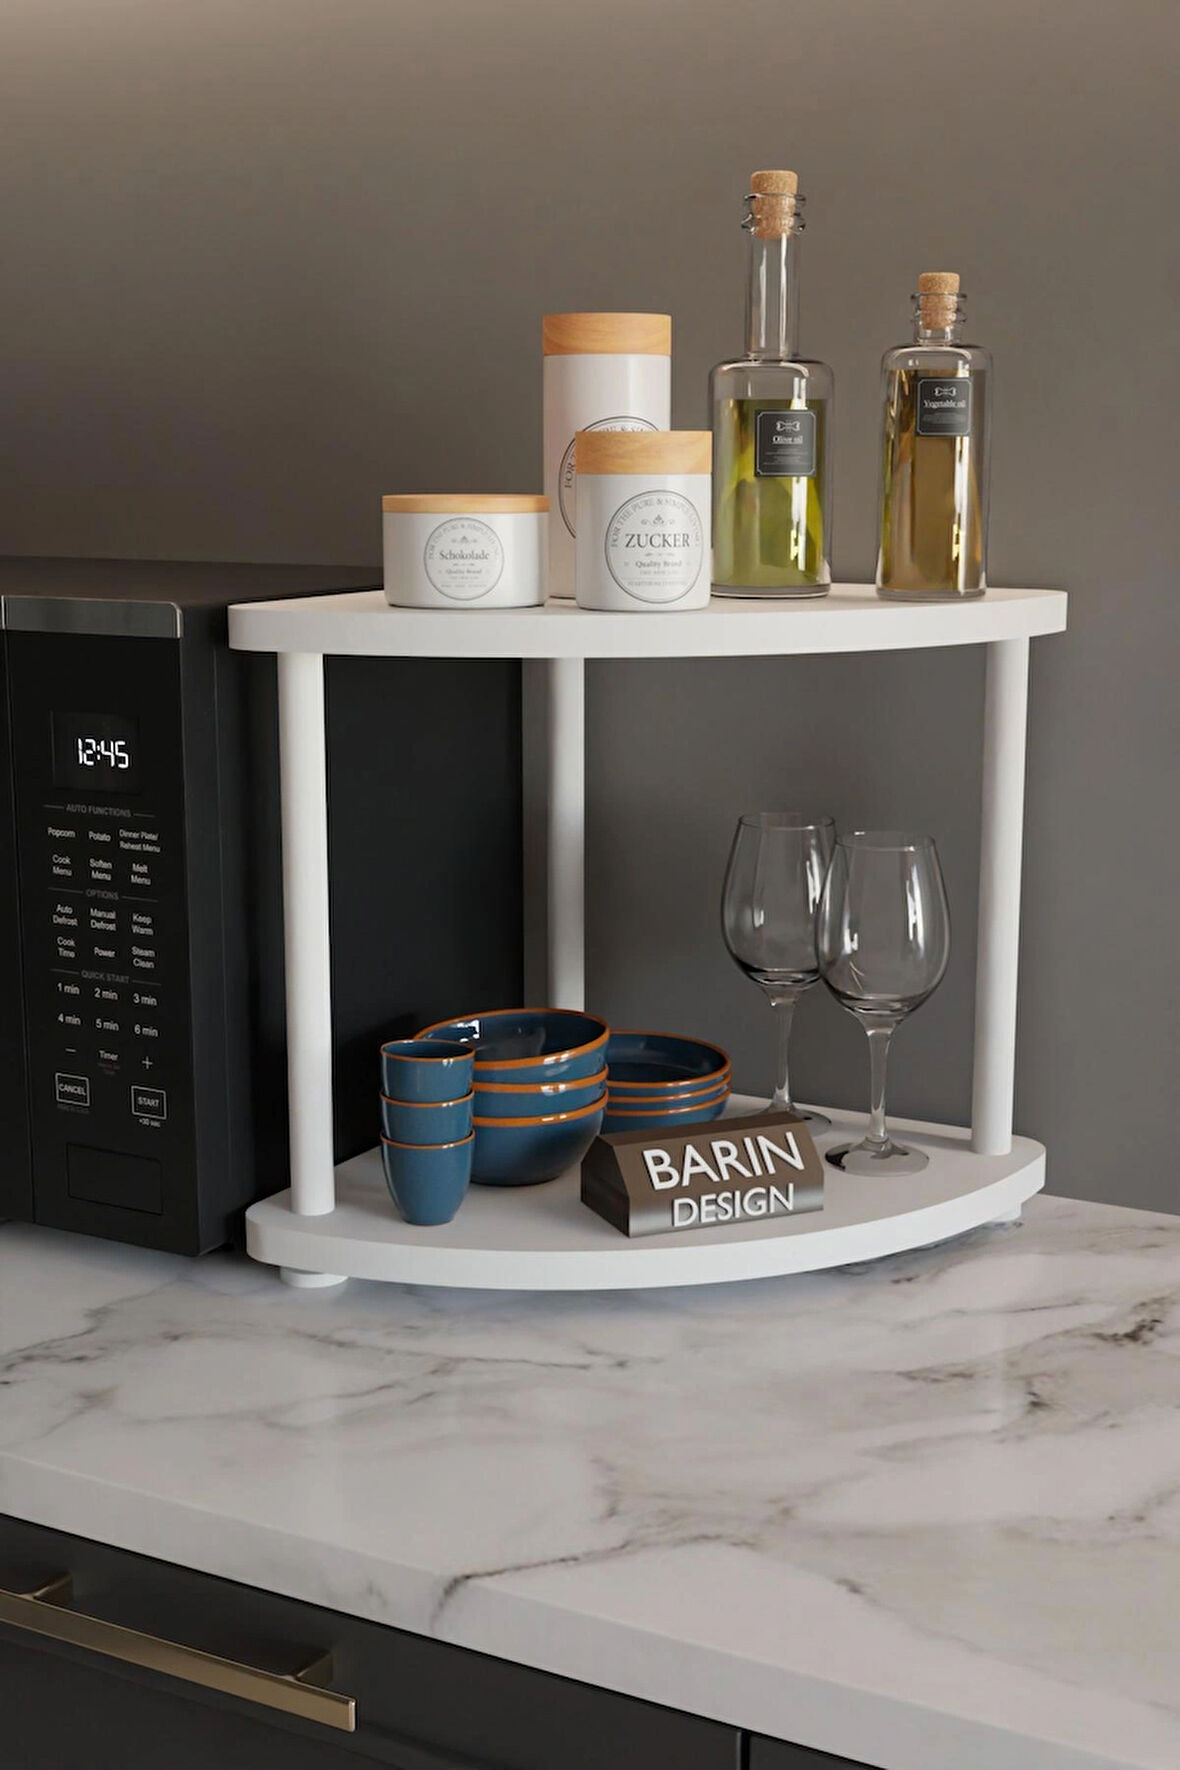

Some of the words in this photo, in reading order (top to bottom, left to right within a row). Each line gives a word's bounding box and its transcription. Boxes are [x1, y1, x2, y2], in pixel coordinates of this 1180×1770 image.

[923, 399, 957, 409] Vegetable
[957, 399, 967, 408] oil
[772, 435, 792, 444] Olive
[793, 435, 803, 444] oil
[624, 533, 690, 548] ZUCKER
[439, 549, 490, 561] Schokolade
[635, 560, 661, 569] Quality
[77, 737, 129, 769] 12:45
[66, 803, 87, 814] AUTO
[88, 805, 131, 817] FUNCTIONS
[88, 831, 111, 842] Potato
[143, 843, 161, 853] Menu
[52, 854, 71, 864] Cook
[89, 858, 112, 869] Soften
[52, 866, 72, 876] Menu
[91, 870, 111, 881] Menu
[131, 875, 151, 885] Menu
[85, 889, 119, 900] OPTIONS
[56, 904, 73, 914] Auto
[90, 908, 116, 919] Manual
[52, 914, 78, 926] Defrost
[132, 913, 152, 924] Keep
[90, 920, 116, 931] Defrost
[132, 925, 153, 935] Warm
[57, 936, 75, 947] Cook
[58, 947, 75, 958] Time
[94, 946, 115, 957] Power
[132, 946, 155, 957] Steam
[133, 958, 154, 968] Clean
[81, 970, 104, 980] QUICK
[106, 972, 130, 983] START
[57, 983, 63, 992] 1
[64, 984, 80, 995] min
[94, 987, 100, 998] 2
[102, 989, 118, 1000] min
[133, 993, 140, 1003] 3
[141, 995, 157, 1006] min
[58, 1013, 64, 1023] 4
[65, 1014, 81, 1025] min
[96, 1018, 102, 1029] 5
[103, 1020, 119, 1031] min
[134, 1024, 141, 1035] 6
[142, 1026, 158, 1037] min
[99, 1050, 118, 1060] Timer
[58, 1083, 87, 1096] CANCEL
[137, 1096, 159, 1107] START
[642, 1131, 805, 1191] BARIN
[673, 1182, 794, 1228] DESIGN
